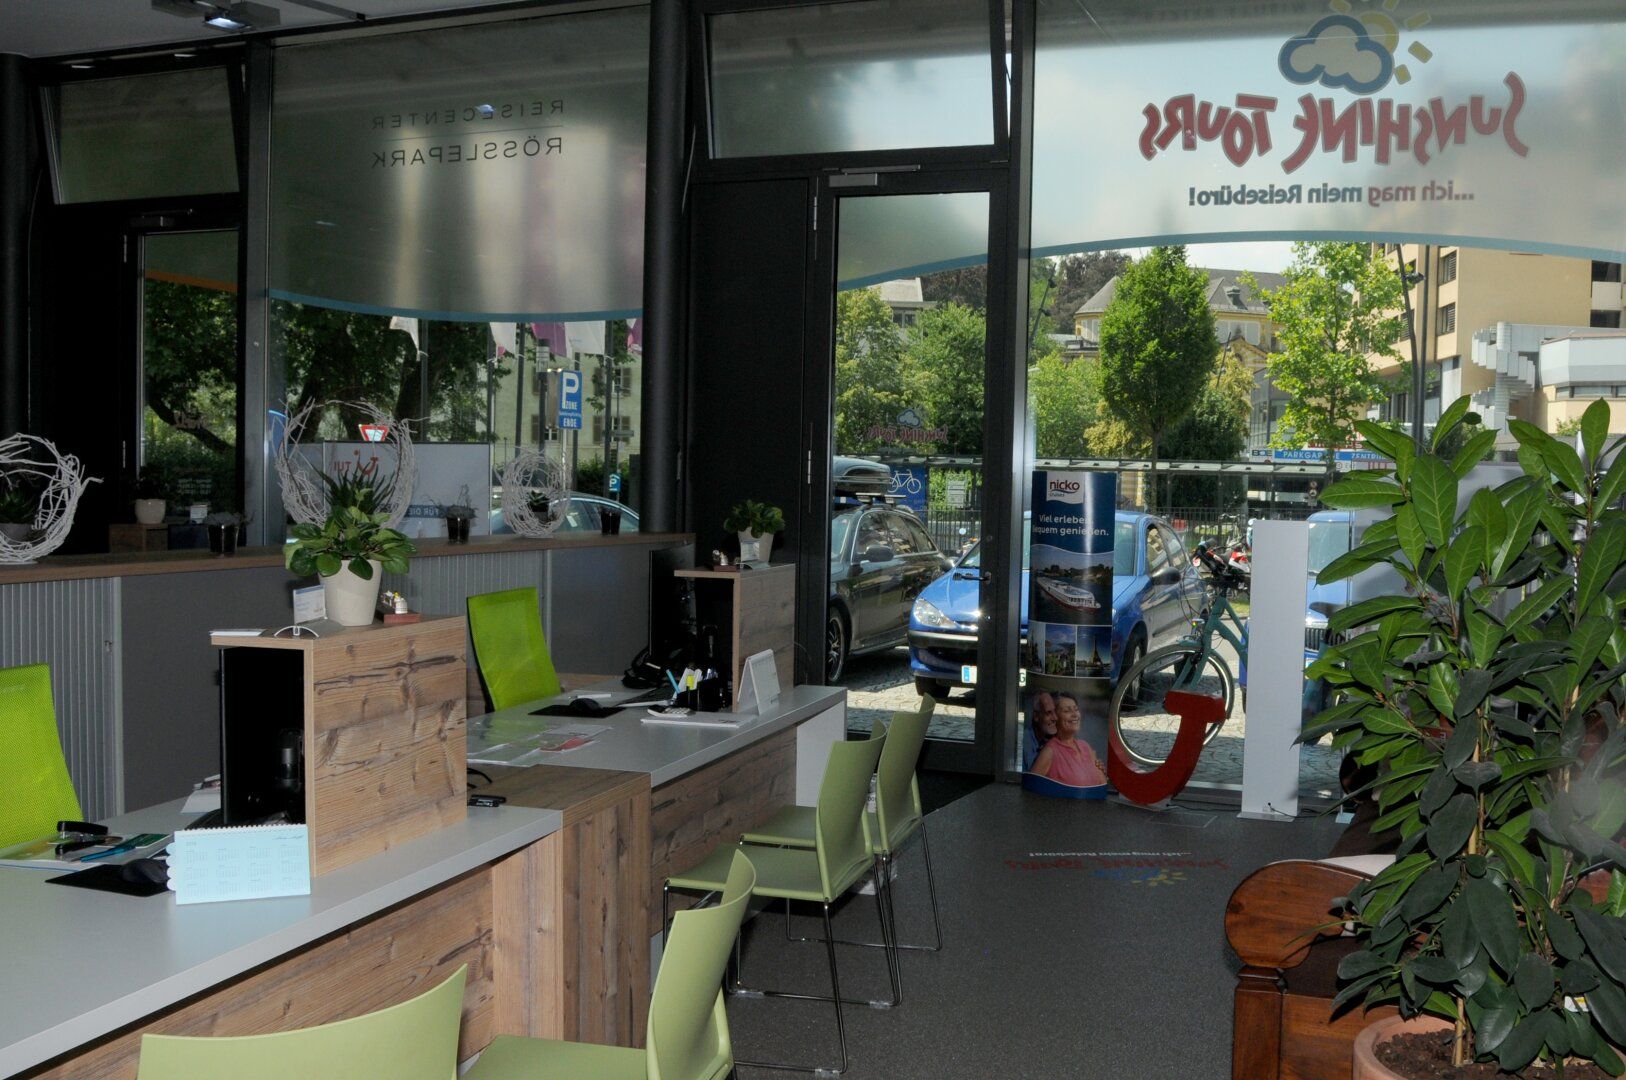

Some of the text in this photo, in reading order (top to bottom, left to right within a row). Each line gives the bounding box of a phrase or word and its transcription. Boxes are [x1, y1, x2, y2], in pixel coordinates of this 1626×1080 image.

[562, 372, 579, 409] P
[1283, 451, 1340, 460] PARKGARE
[1049, 479, 1080, 490] nicko
[1039, 514, 1053, 523] Viel
